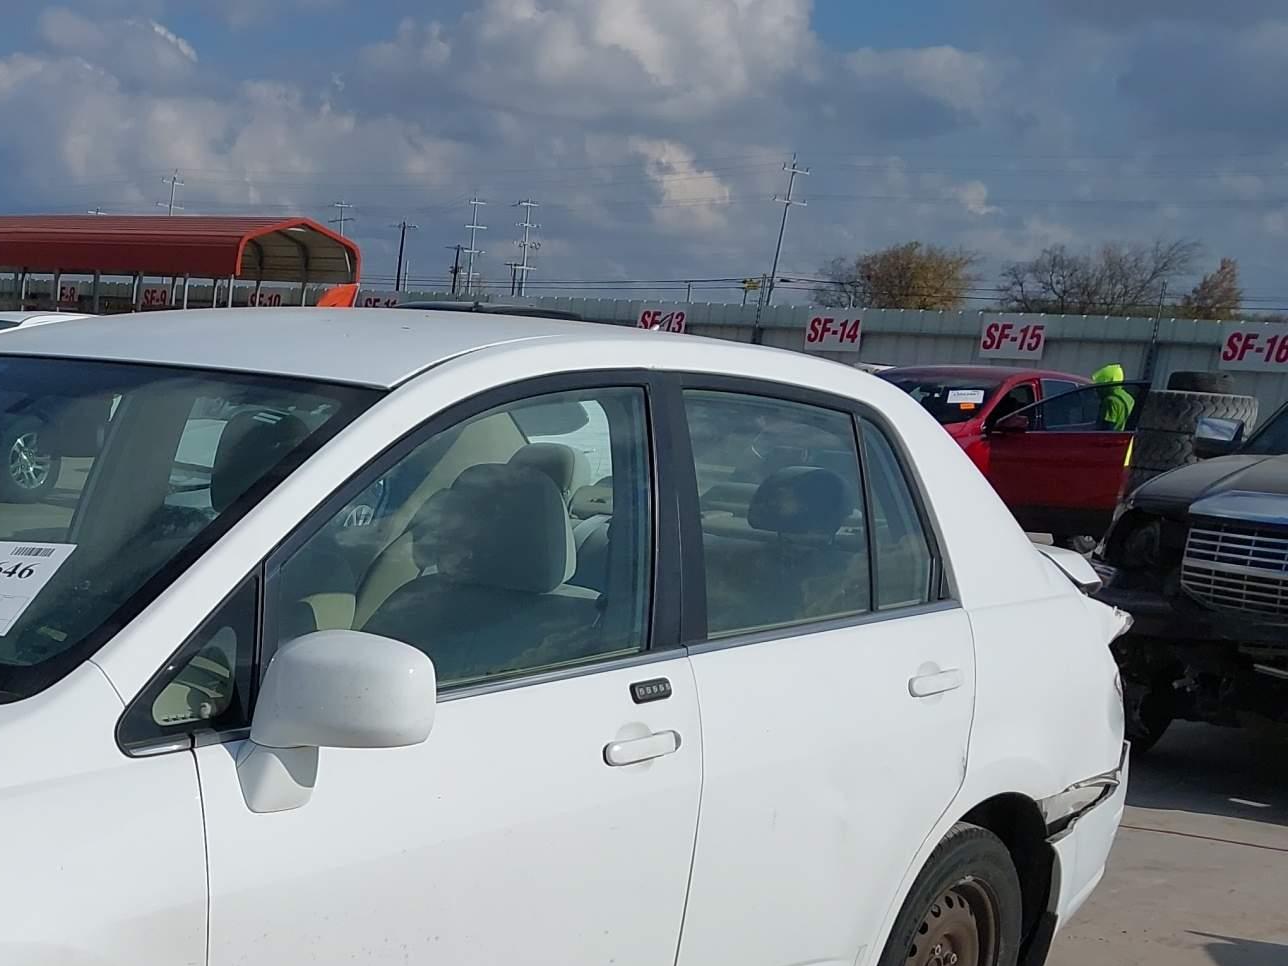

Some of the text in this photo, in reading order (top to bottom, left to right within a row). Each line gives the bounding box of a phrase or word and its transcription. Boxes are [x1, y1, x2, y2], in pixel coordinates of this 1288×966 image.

[144, 289, 168, 306] SF-9
[807, 317, 861, 344] SF-14
[982, 323, 1045, 351] SF-15
[1222, 332, 1288, 364] SF-16
